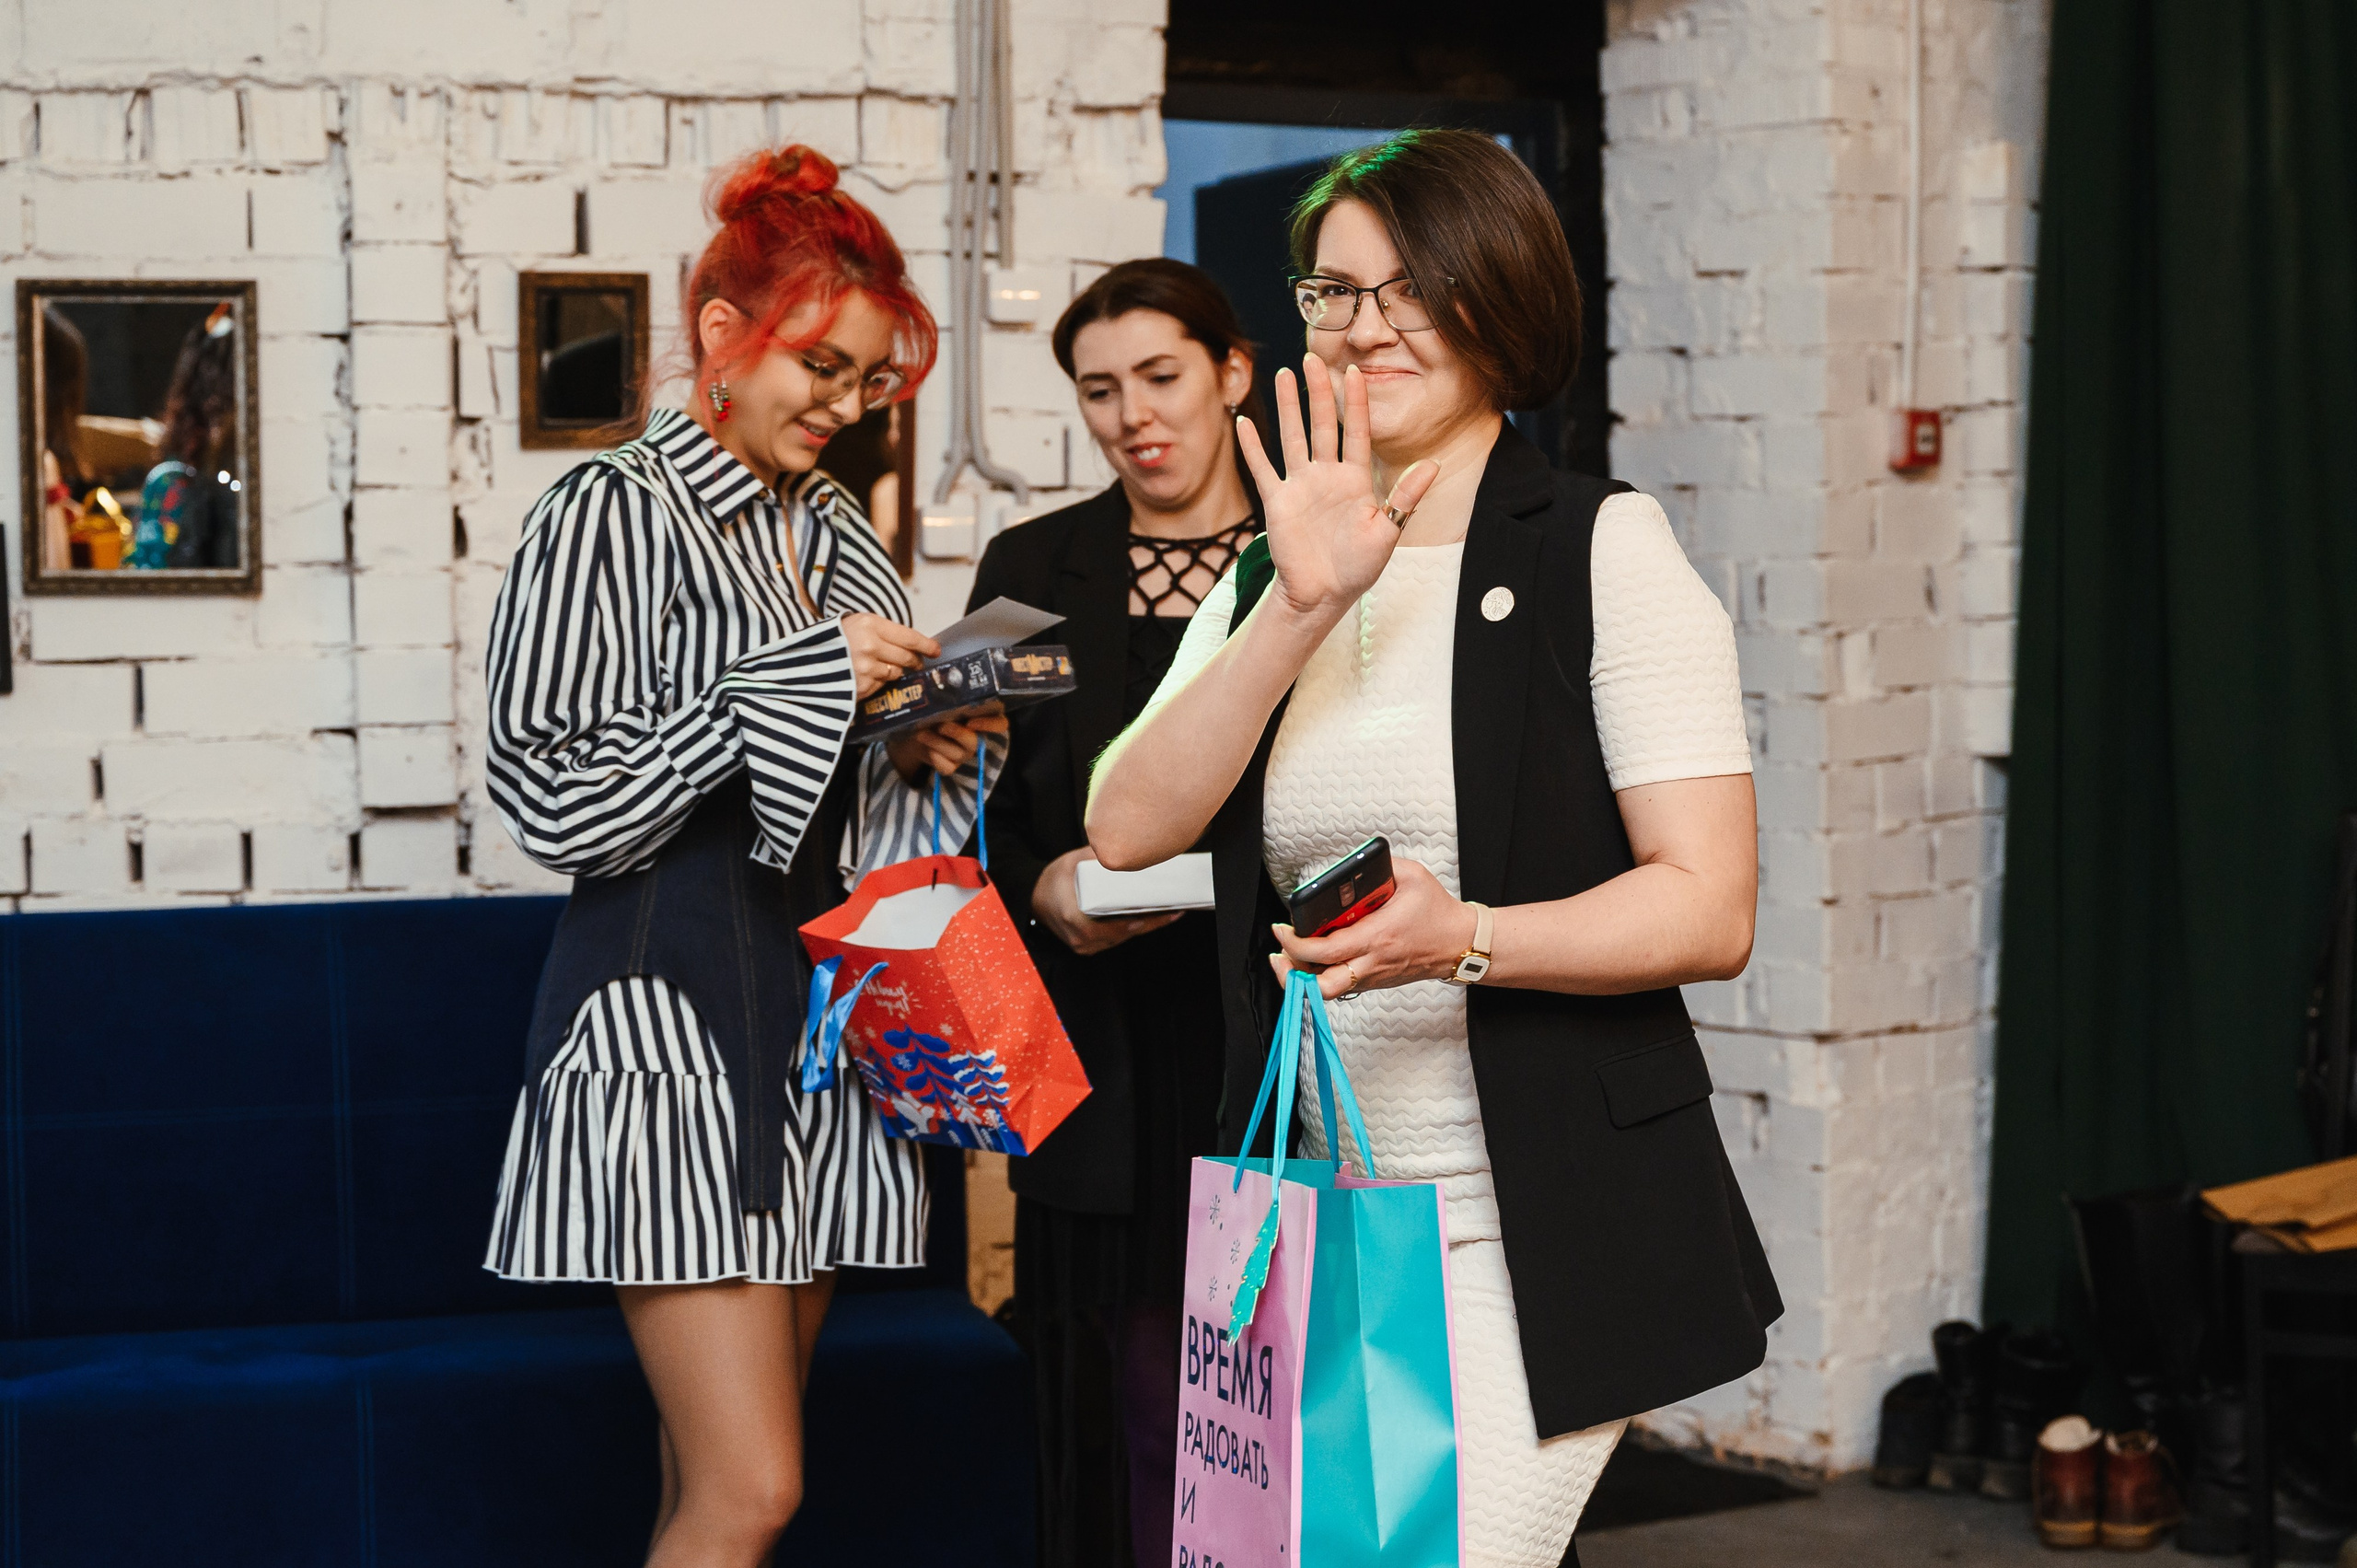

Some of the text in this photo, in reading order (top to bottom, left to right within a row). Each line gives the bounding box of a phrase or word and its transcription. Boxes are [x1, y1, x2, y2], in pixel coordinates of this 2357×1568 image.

[1187, 1315, 1272, 1420] ВРЕМЯ
[1184, 1411, 1269, 1490] РАДОВАТЬ
[1181, 1477, 1196, 1524] И
